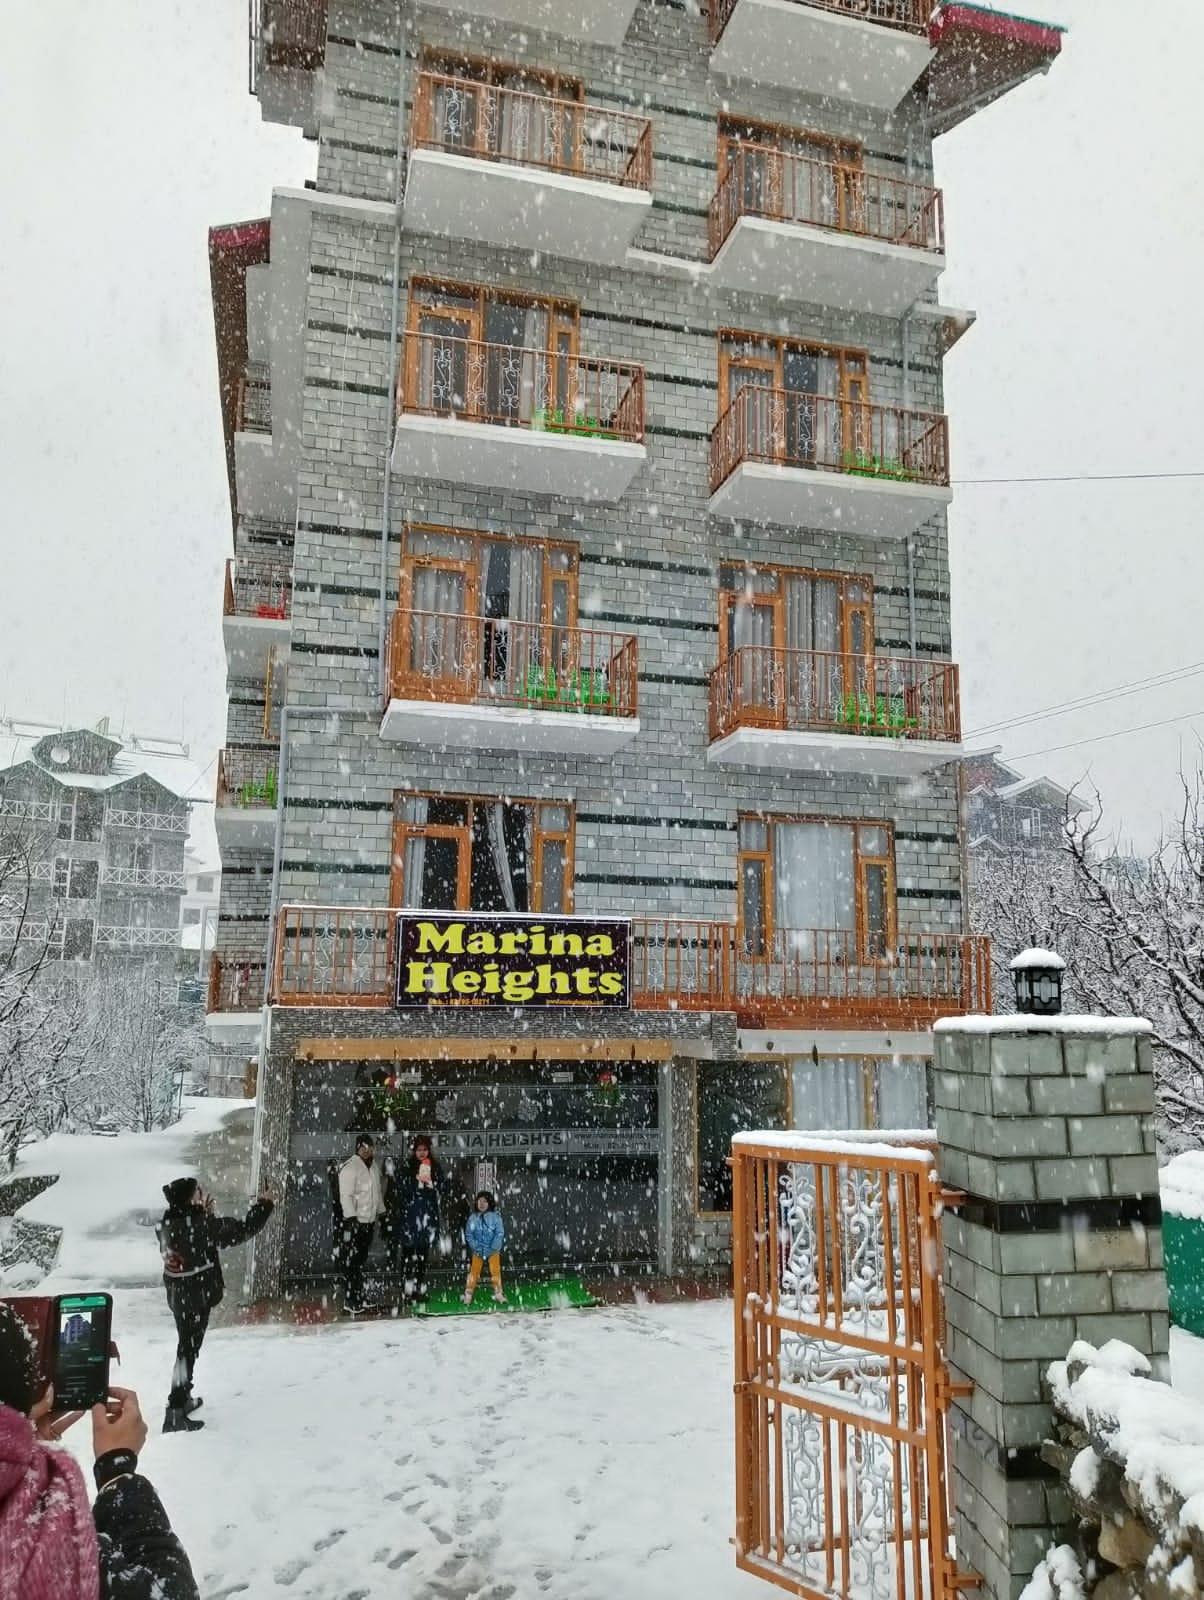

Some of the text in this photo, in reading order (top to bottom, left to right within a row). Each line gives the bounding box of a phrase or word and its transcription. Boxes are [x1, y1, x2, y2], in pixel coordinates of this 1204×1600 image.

[415, 922, 616, 956] Marina
[404, 961, 624, 1001] Heights
[488, 1131, 563, 1146] HEIGHTS
